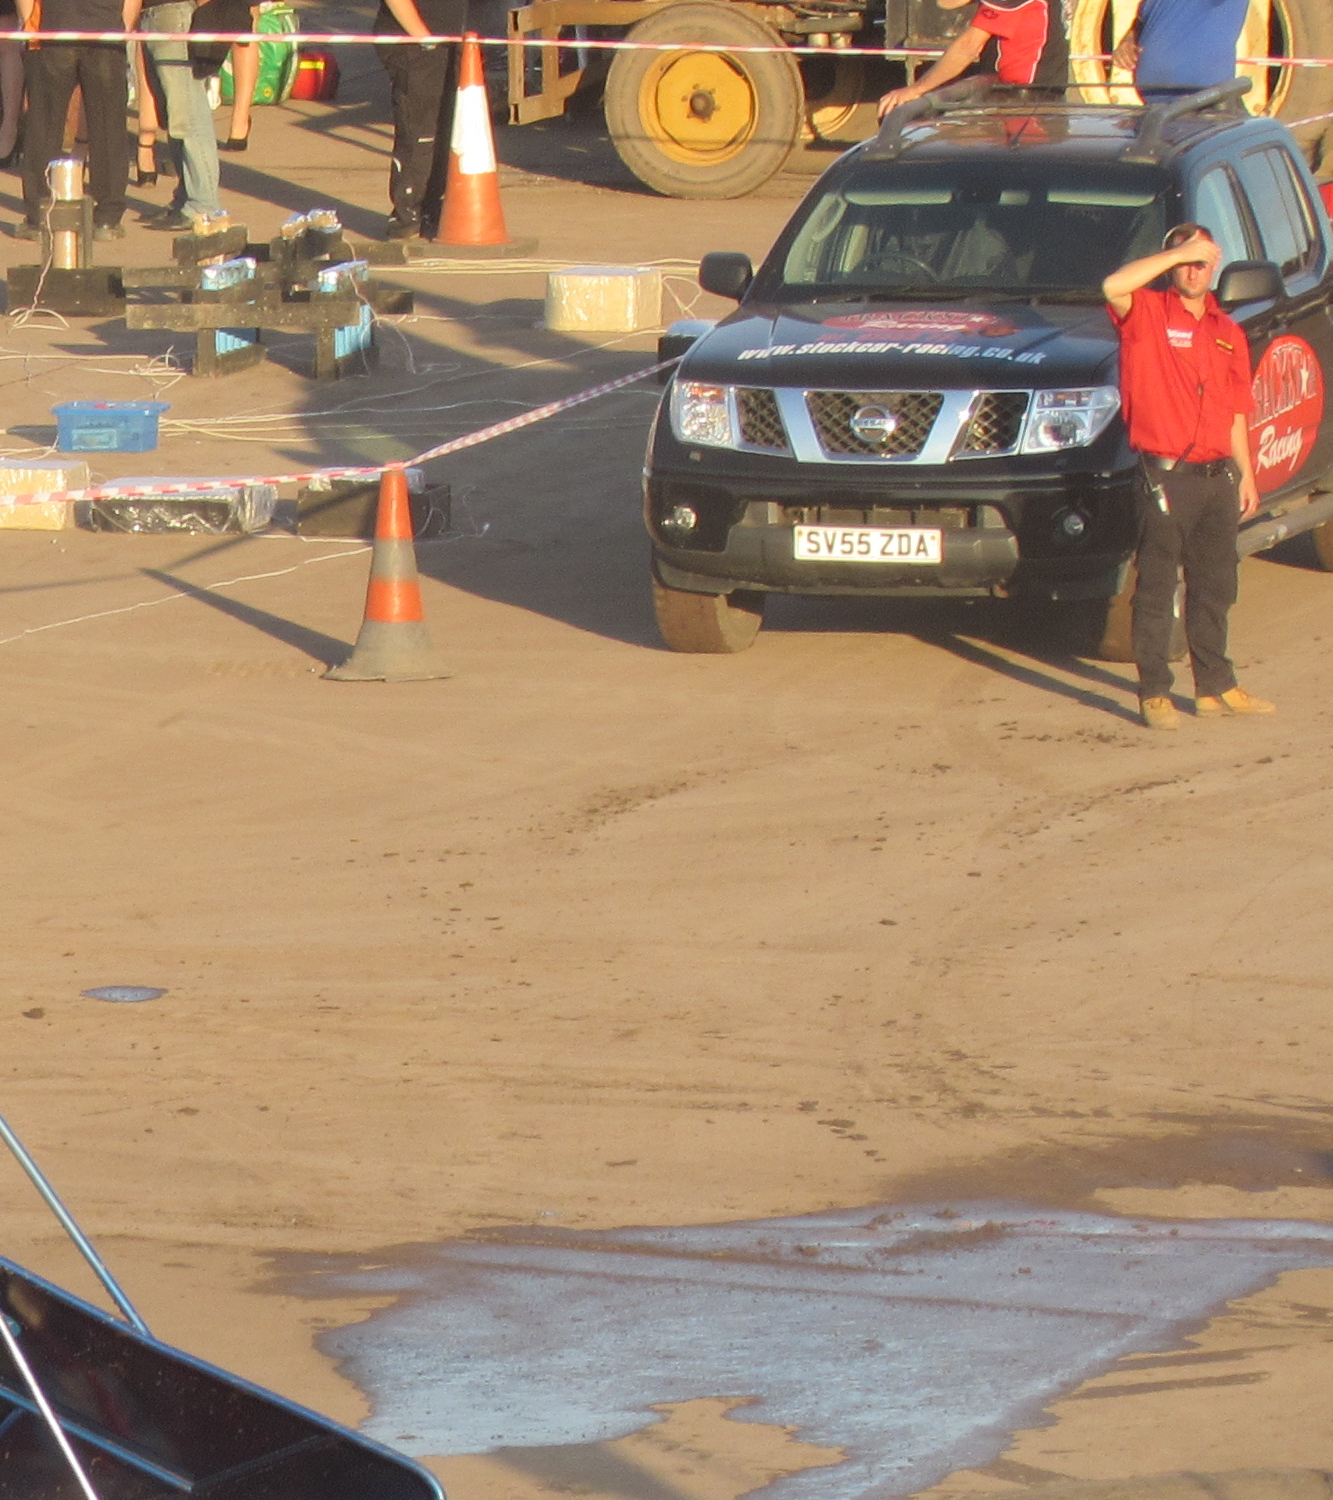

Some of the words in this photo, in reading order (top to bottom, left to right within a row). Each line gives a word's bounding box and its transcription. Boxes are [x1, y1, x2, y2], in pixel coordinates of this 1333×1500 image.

[737, 340, 1046, 364] www.stockcar-racing.co.uk
[1255, 425, 1303, 475] Racing
[806, 530, 872, 555] SV55
[879, 533, 929, 557] ZDA
